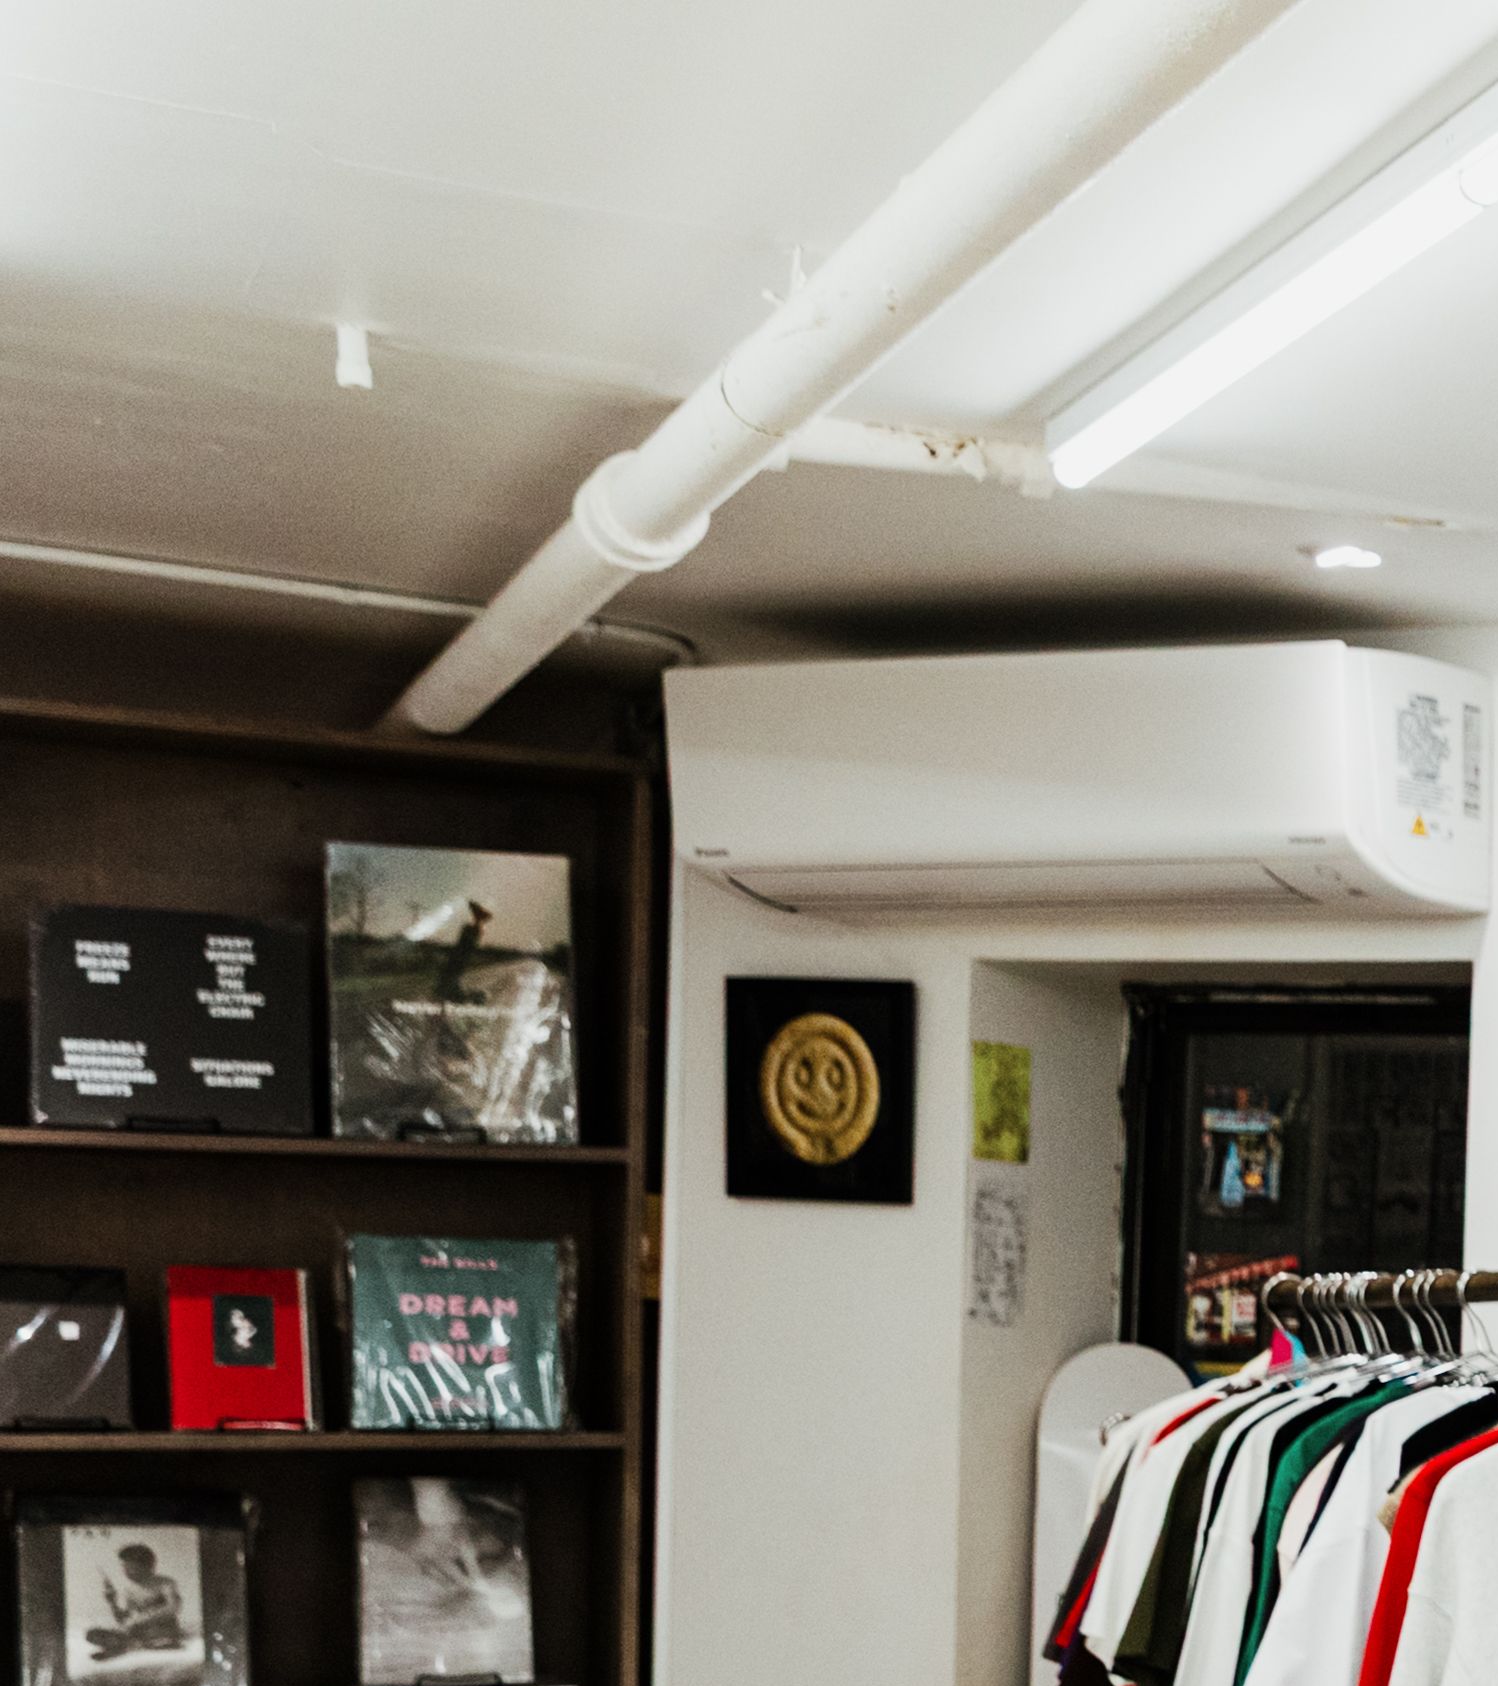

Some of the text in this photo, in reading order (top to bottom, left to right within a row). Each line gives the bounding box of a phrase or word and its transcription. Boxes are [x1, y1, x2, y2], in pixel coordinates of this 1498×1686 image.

[400, 1293, 518, 1318] DREAM
[449, 1319, 470, 1341] &
[408, 1341, 511, 1365] DRIVE
